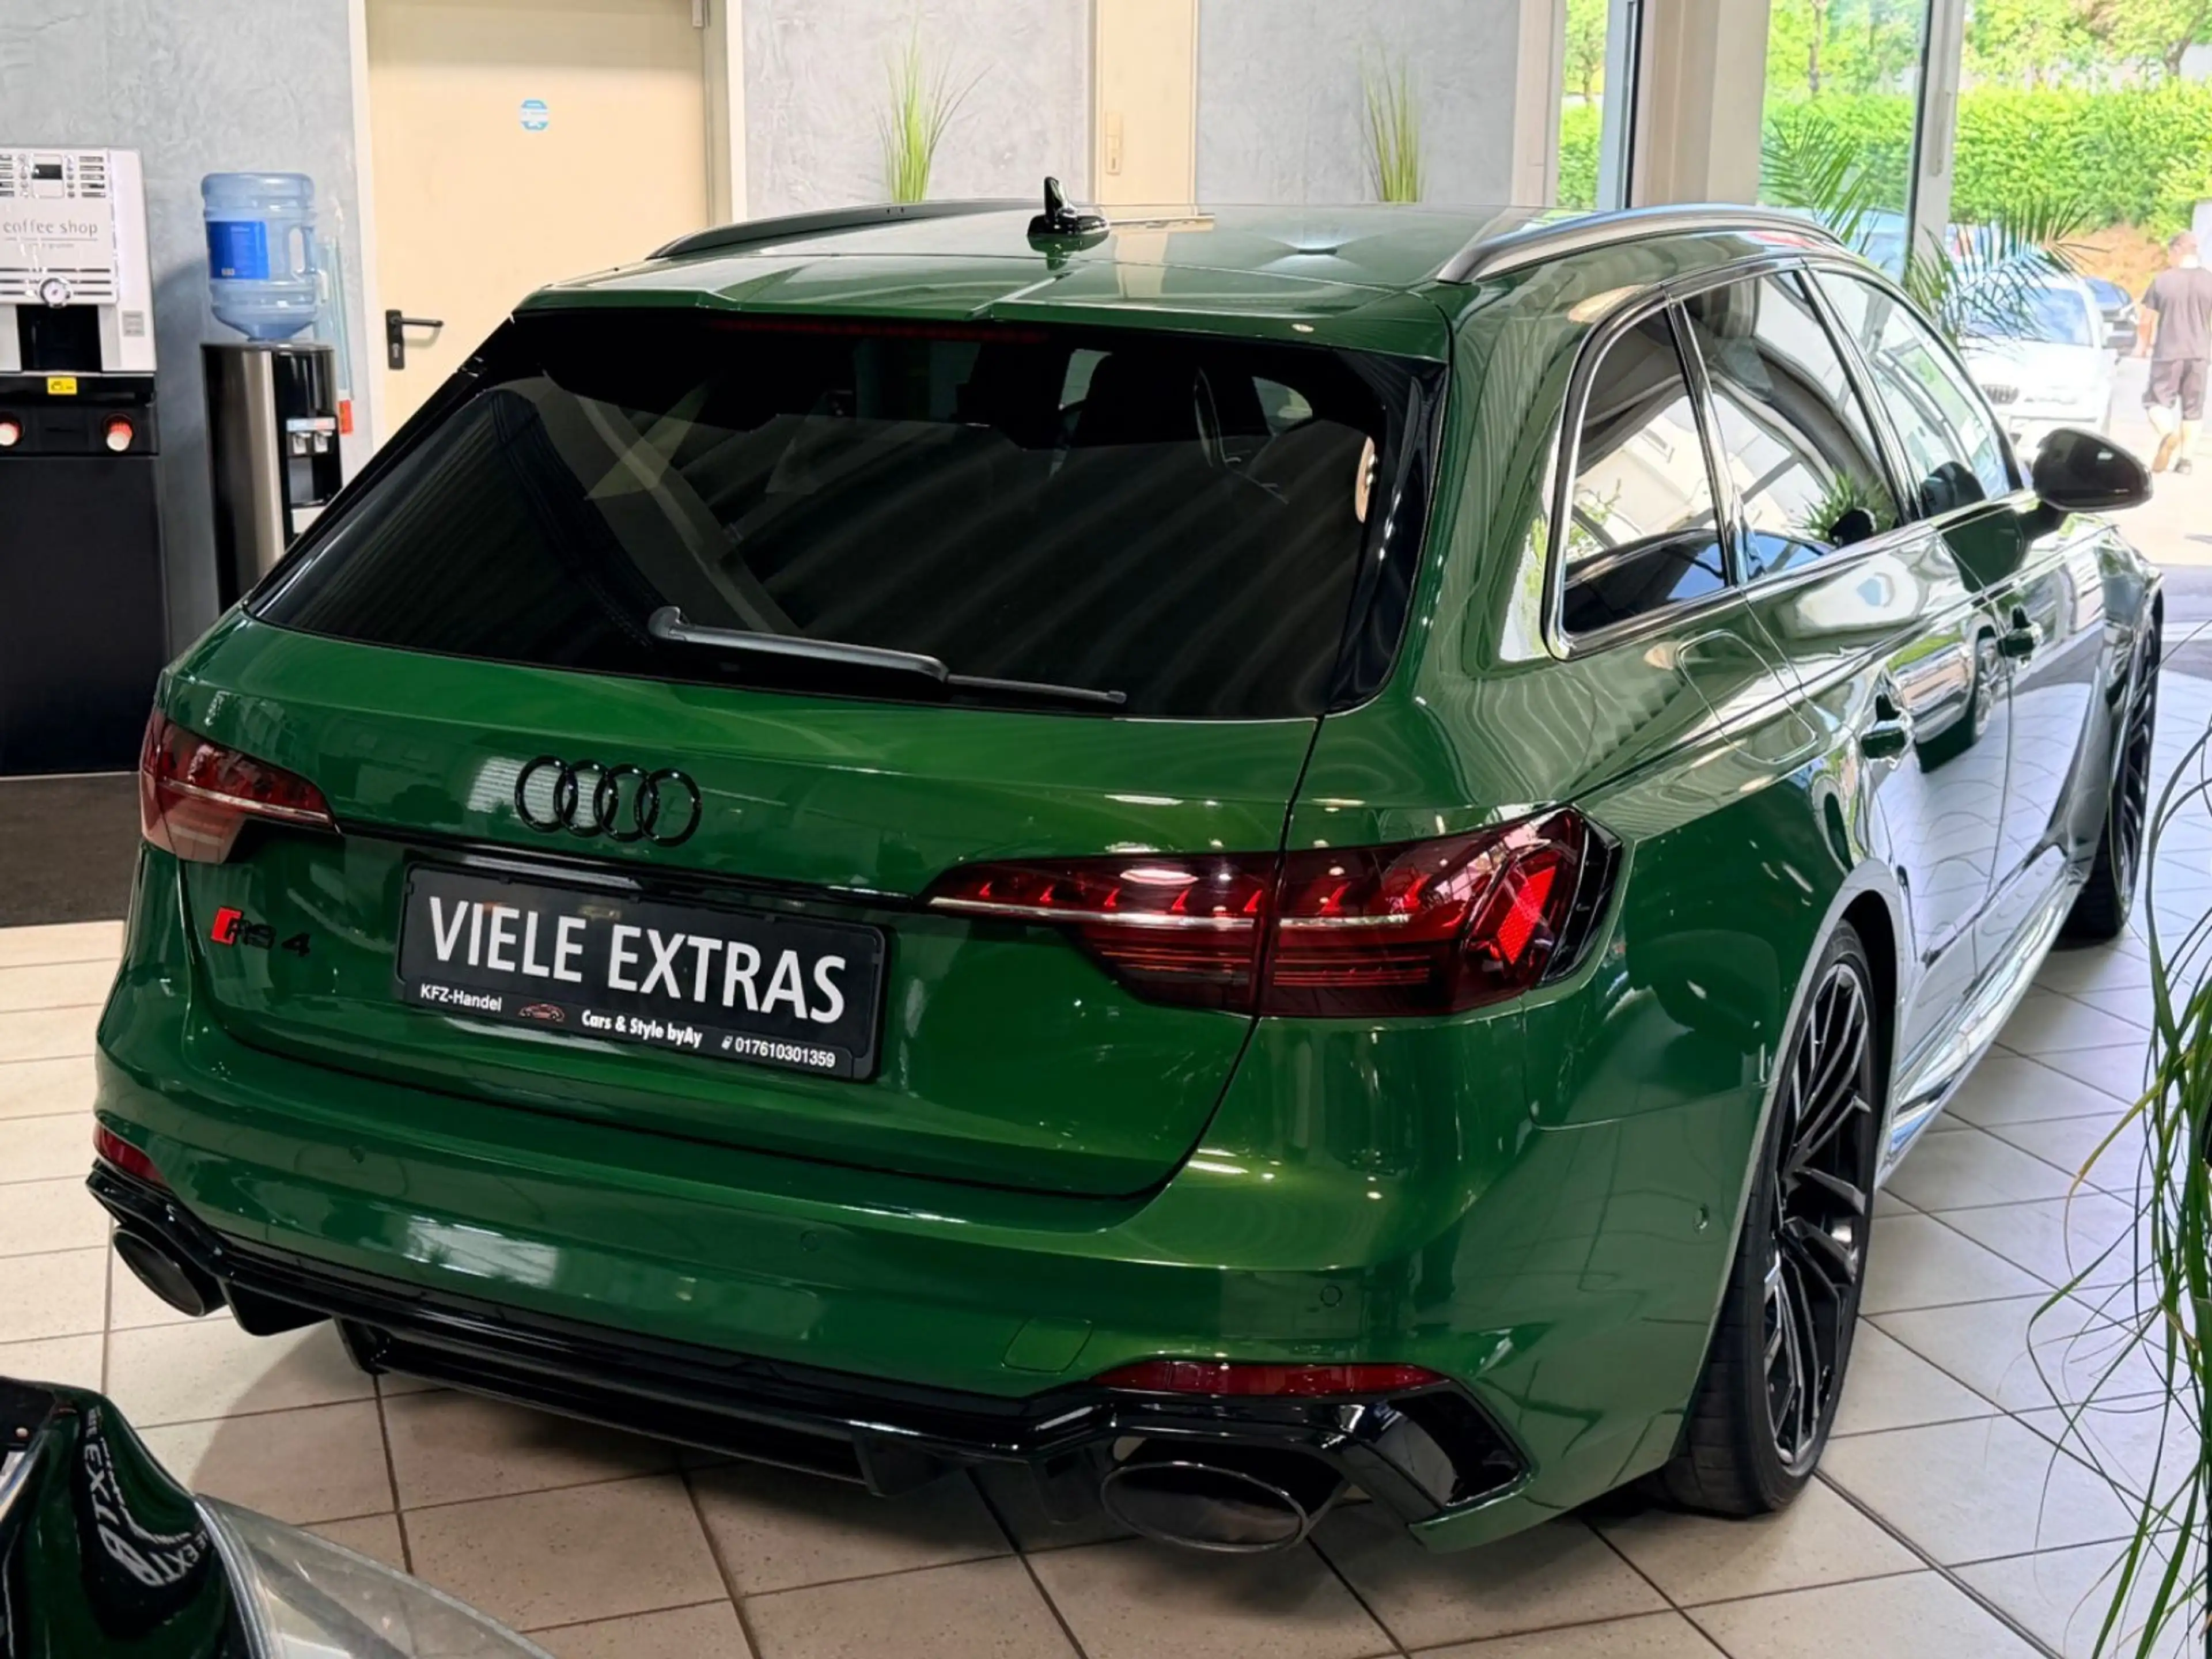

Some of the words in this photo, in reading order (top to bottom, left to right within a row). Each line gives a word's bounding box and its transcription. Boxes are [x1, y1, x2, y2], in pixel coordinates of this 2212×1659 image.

[3, 218, 54, 234] coffee
[59, 219, 99, 237] shop
[429, 896, 587, 983] VIELE
[608, 924, 847, 1024] EXTRAS
[420, 983, 502, 1012] KFZ-Handel
[581, 1009, 612, 1030] Cars
[615, 1016, 626, 1033] &
[630, 1018, 664, 1040] Style
[734, 1039, 836, 1068] 017610301359
